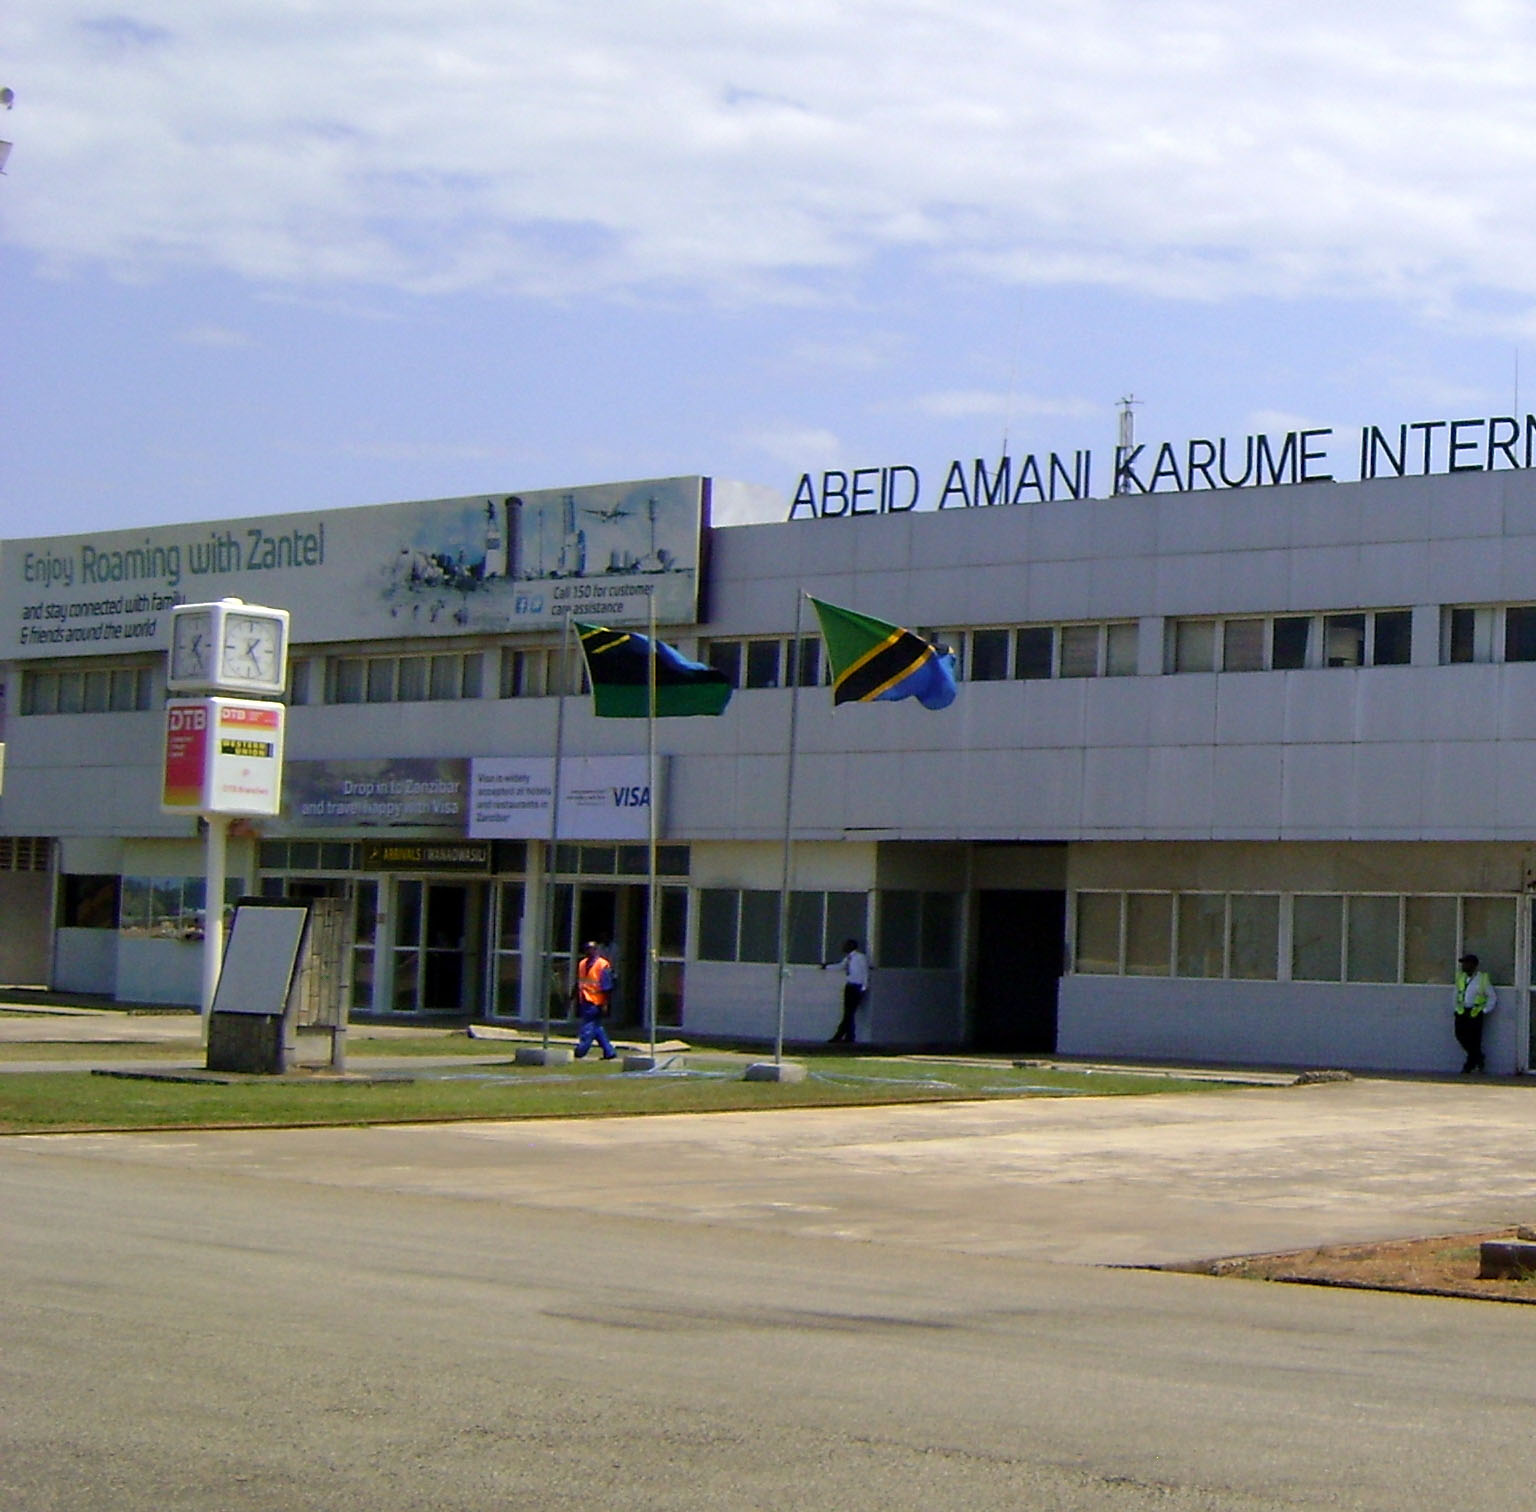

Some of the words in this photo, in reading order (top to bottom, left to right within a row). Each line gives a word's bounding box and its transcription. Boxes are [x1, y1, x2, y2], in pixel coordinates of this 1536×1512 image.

[787, 465, 920, 522] ABEID
[938, 449, 1092, 512] AMANI
[1114, 428, 1335, 497] KARUME
[23, 552, 73, 588] Enjoy
[82, 539, 181, 586] Roaming
[188, 530, 240, 575] with
[247, 522, 324, 571] Zantel
[553, 585, 570, 600] Call
[573, 584, 591, 599] 150
[593, 583, 607, 597] for
[609, 583, 654, 597] customer
[22, 602, 42, 620] and
[44, 600, 67, 622] stay
[69, 596, 123, 618] connected
[125, 593, 151, 614] with
[28, 626, 63, 645] friends
[65, 624, 102, 642] around
[103, 622, 121, 640] the
[123, 619, 157, 638] world
[169, 709, 206, 731] DTB
[222, 708, 246, 720] DTB
[222, 740, 267, 749] WESTERN
[235, 748, 266, 757] UNION
[344, 780, 375, 796] Drop
[613, 787, 650, 806] VISA
